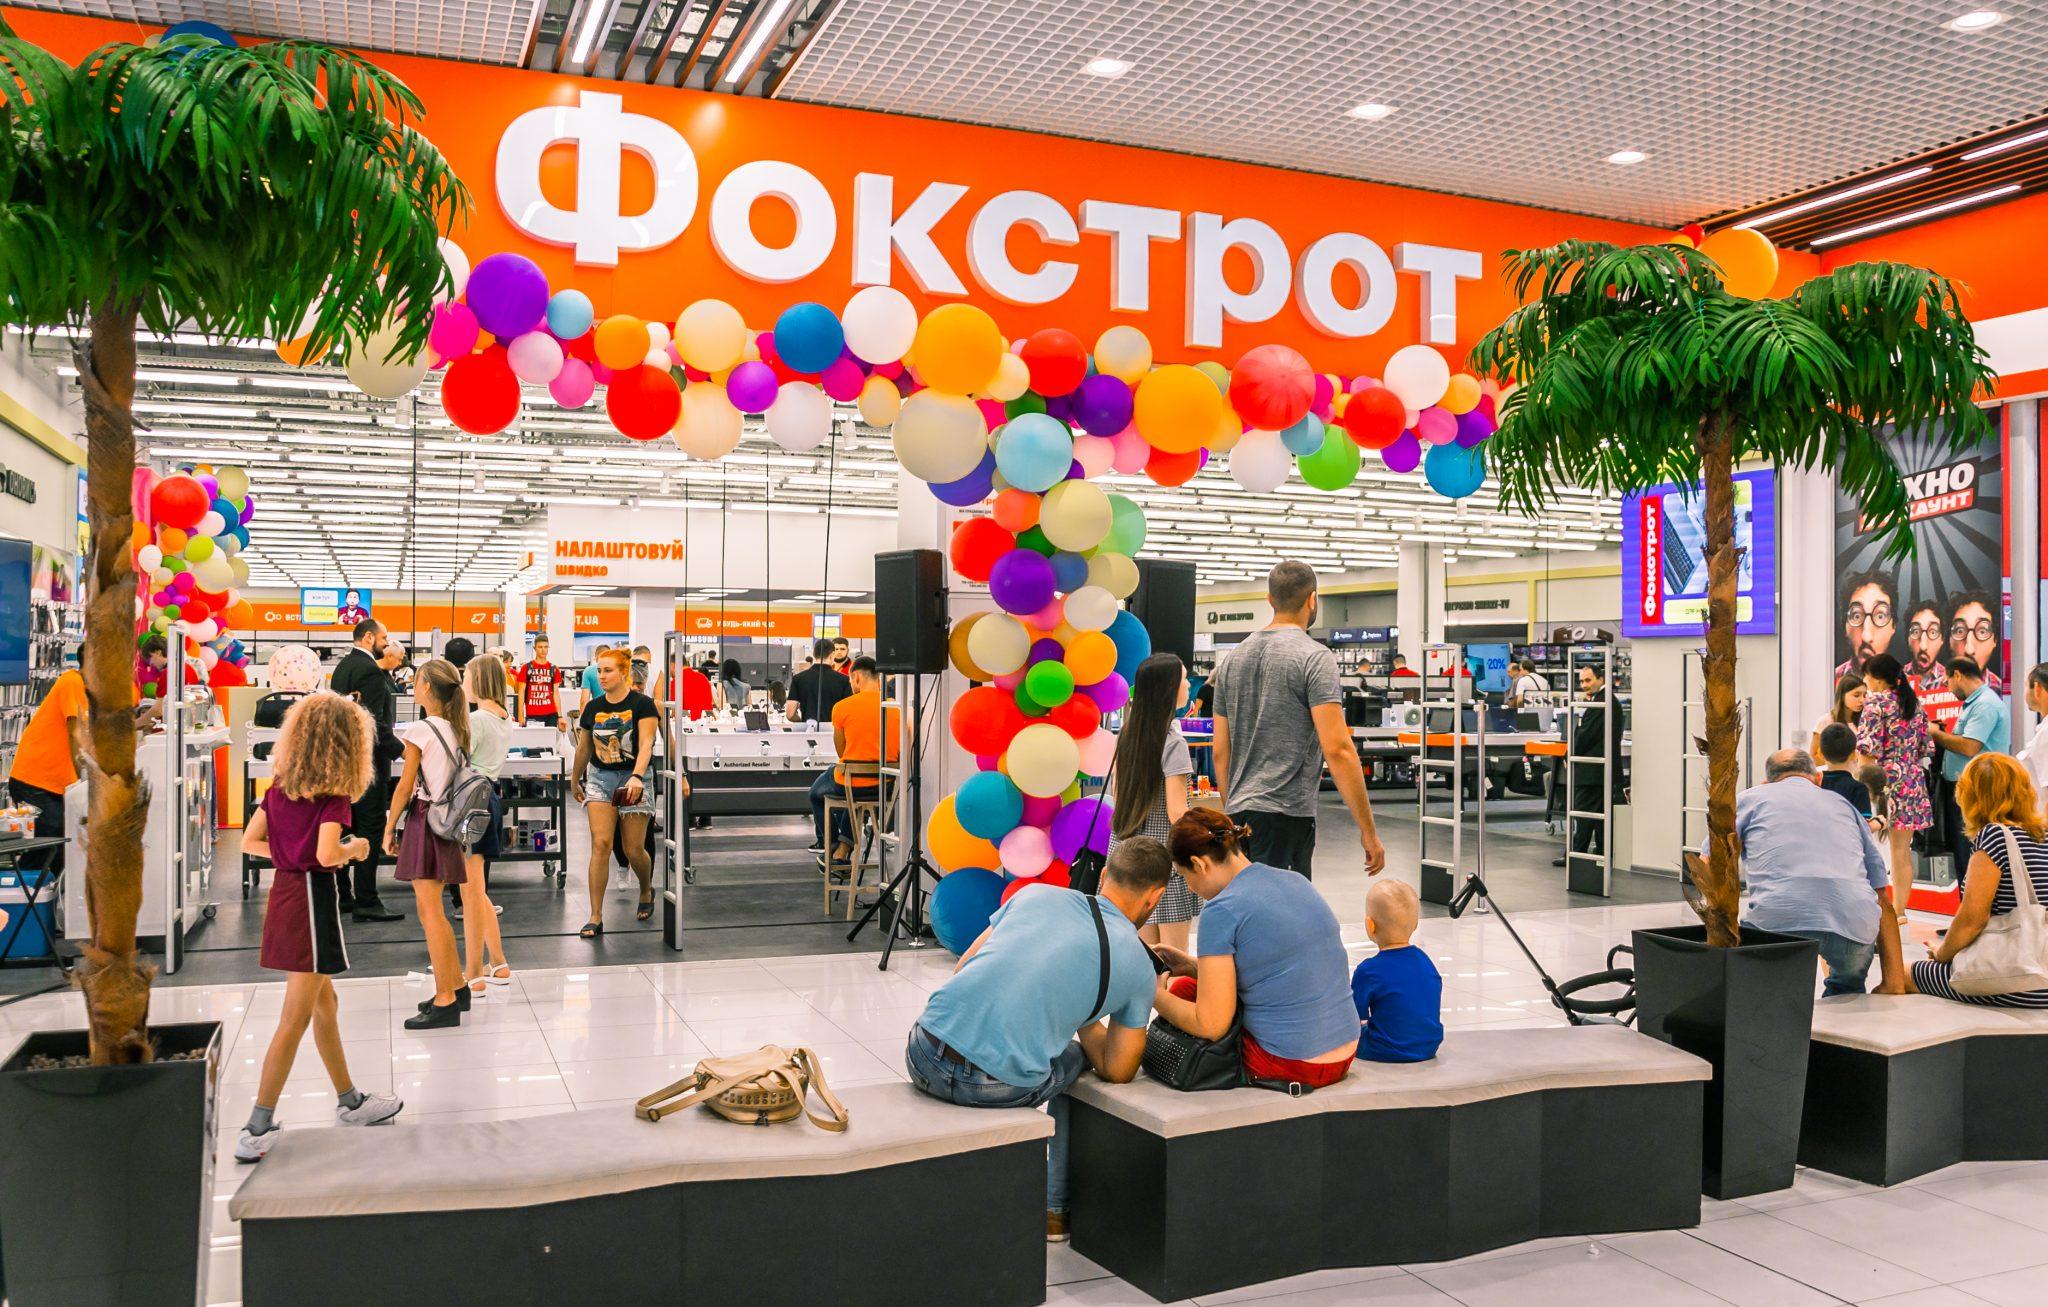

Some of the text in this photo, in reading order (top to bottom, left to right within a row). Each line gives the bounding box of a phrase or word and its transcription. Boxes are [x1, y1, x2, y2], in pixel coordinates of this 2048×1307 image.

[495, 90, 1483, 349] Фокстрот
[555, 539, 684, 561] НАЛАШТОВУЙ
[555, 564, 608, 577] ШВИДКО
